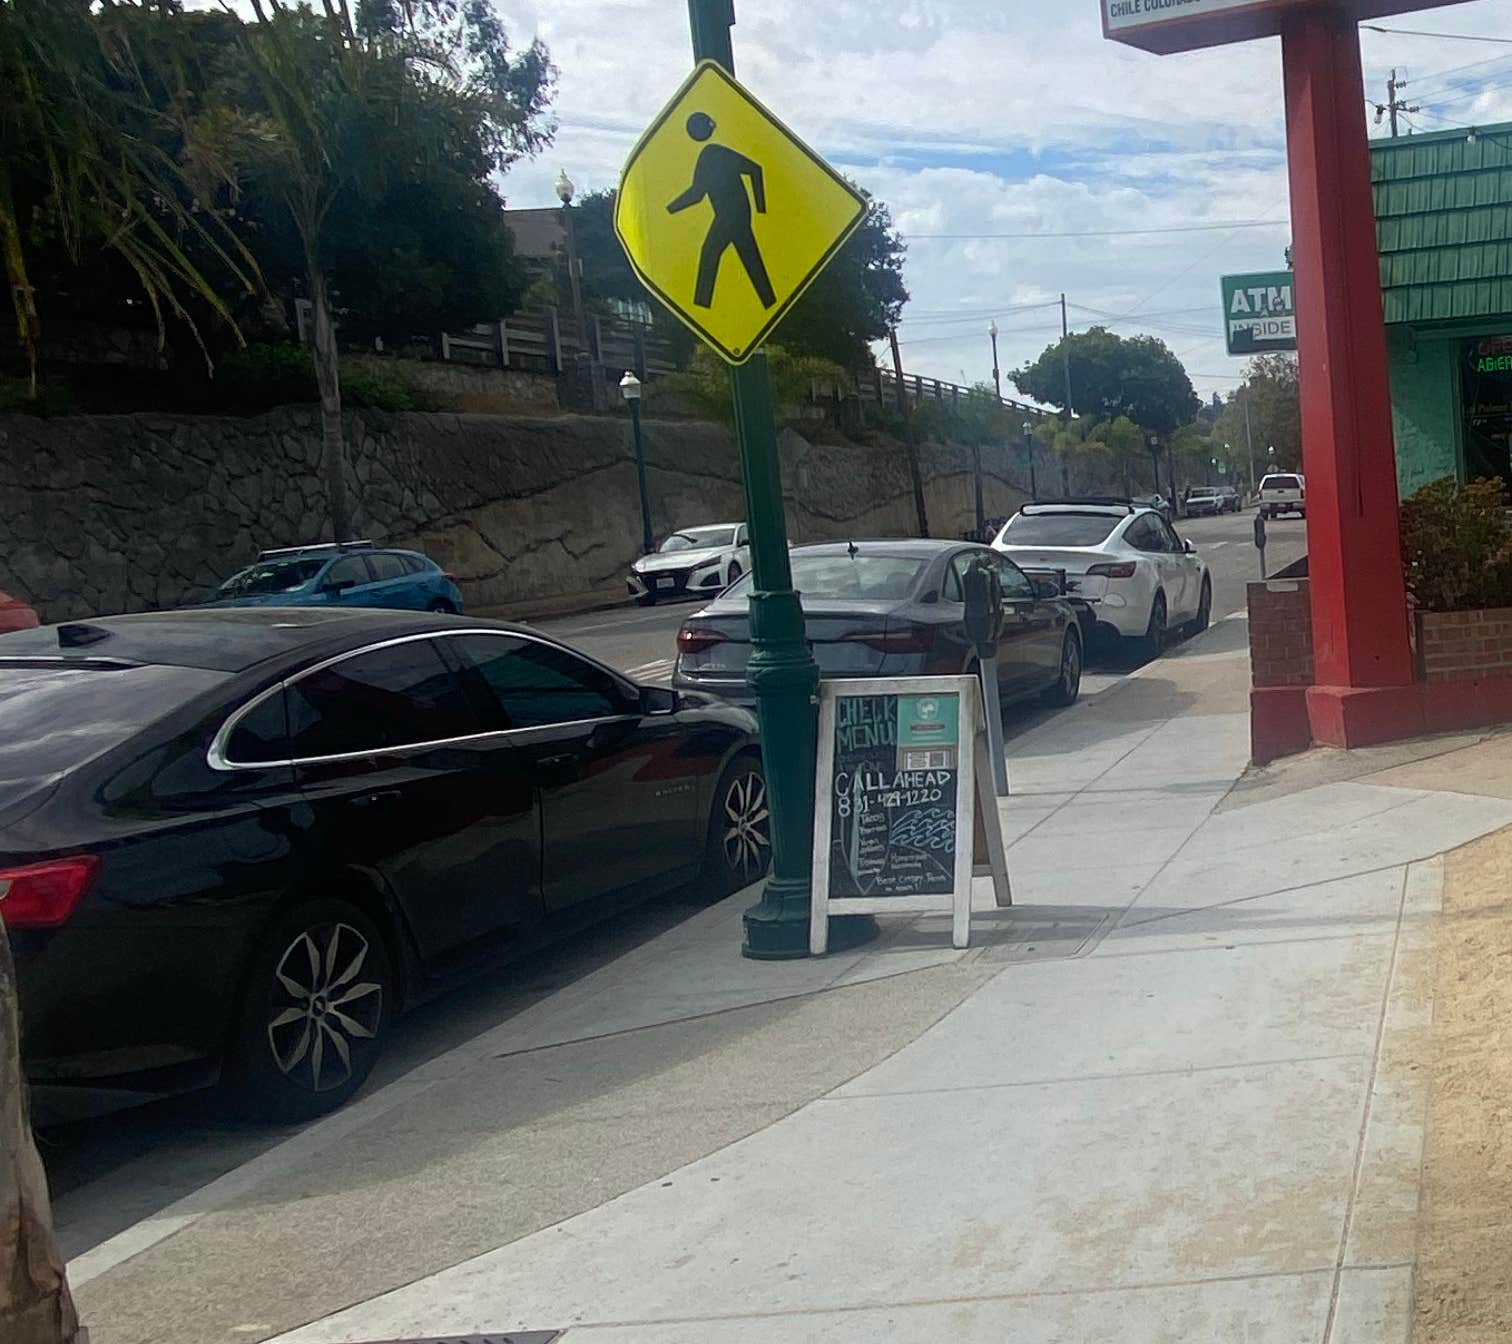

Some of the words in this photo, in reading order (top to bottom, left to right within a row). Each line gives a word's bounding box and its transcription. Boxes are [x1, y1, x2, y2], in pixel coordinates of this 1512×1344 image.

[1110, 0, 1141, 17] CHILE
[1231, 286, 1291, 313] ATM
[835, 772, 890, 796] CALL
[893, 770, 951, 788] AHEAD
